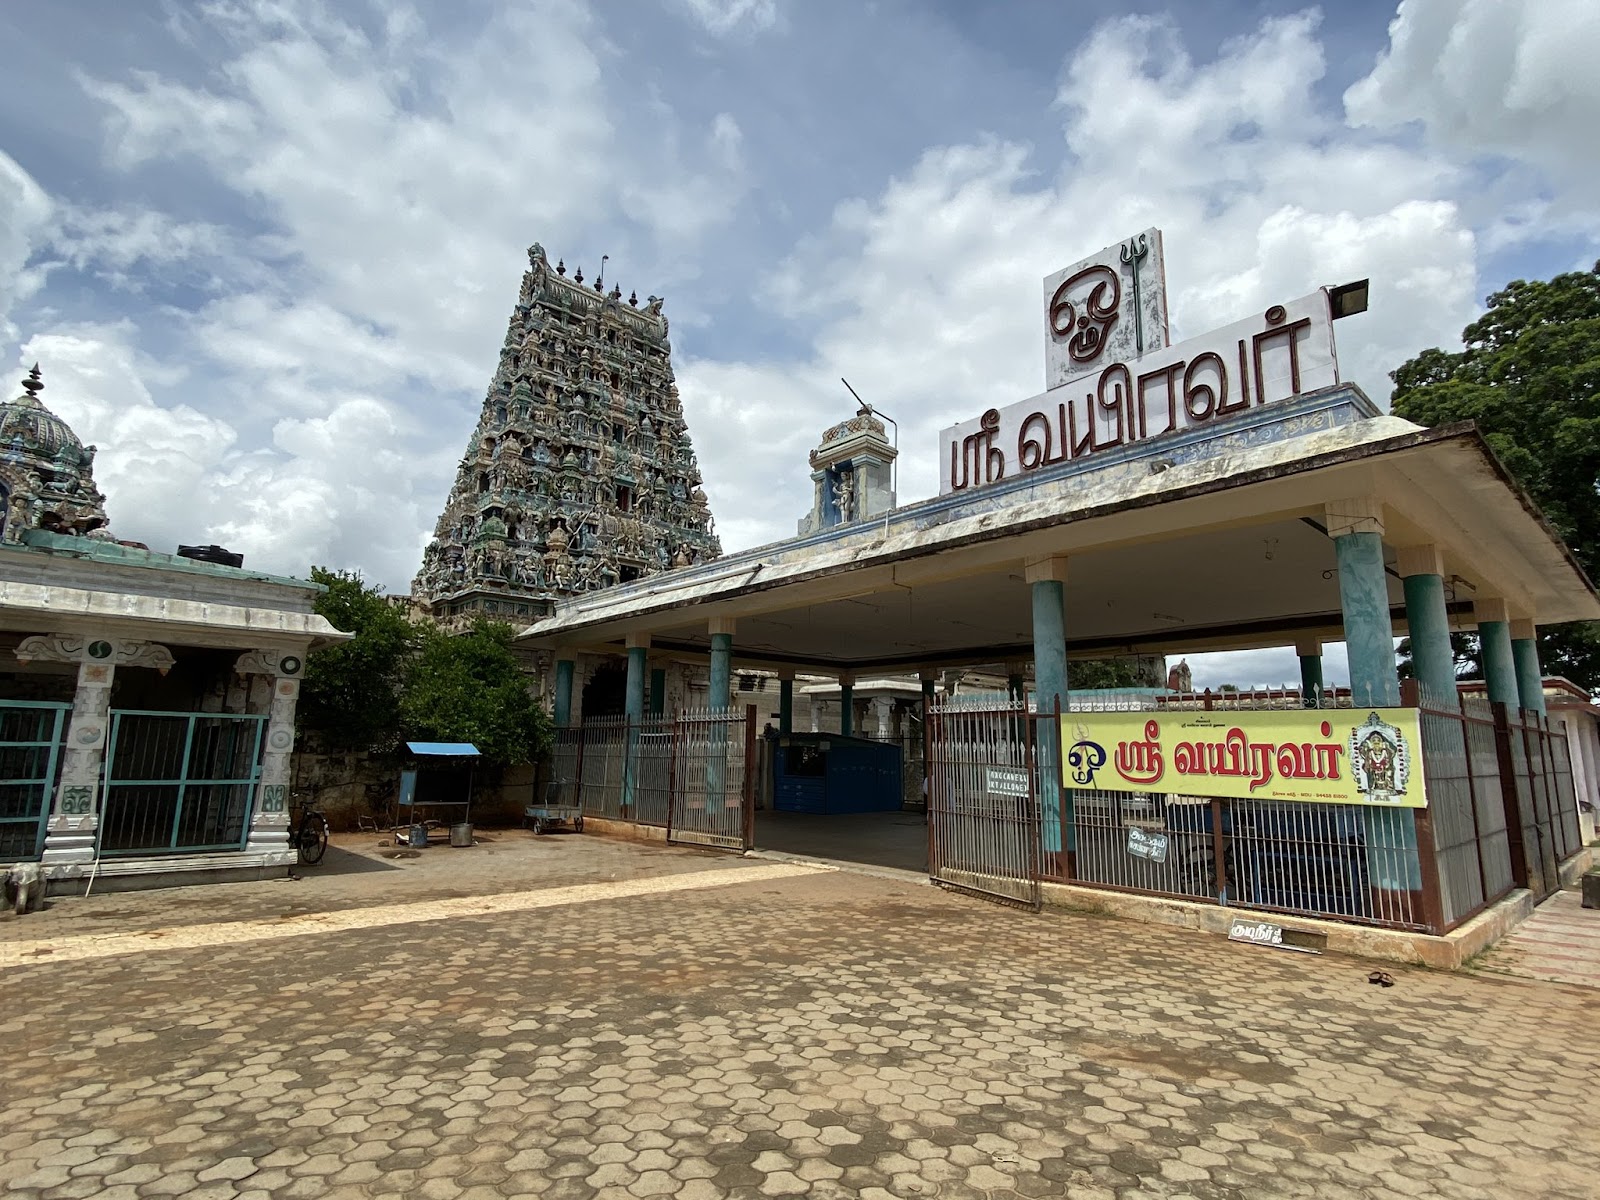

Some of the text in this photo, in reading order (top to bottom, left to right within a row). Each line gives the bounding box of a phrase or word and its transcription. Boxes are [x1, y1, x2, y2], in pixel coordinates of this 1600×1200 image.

[1018, 304, 1311, 471] வயிரவர்
[1174, 720, 1345, 792] வயிரவர்
[1231, 924, 1274, 941] குடிநீர்
